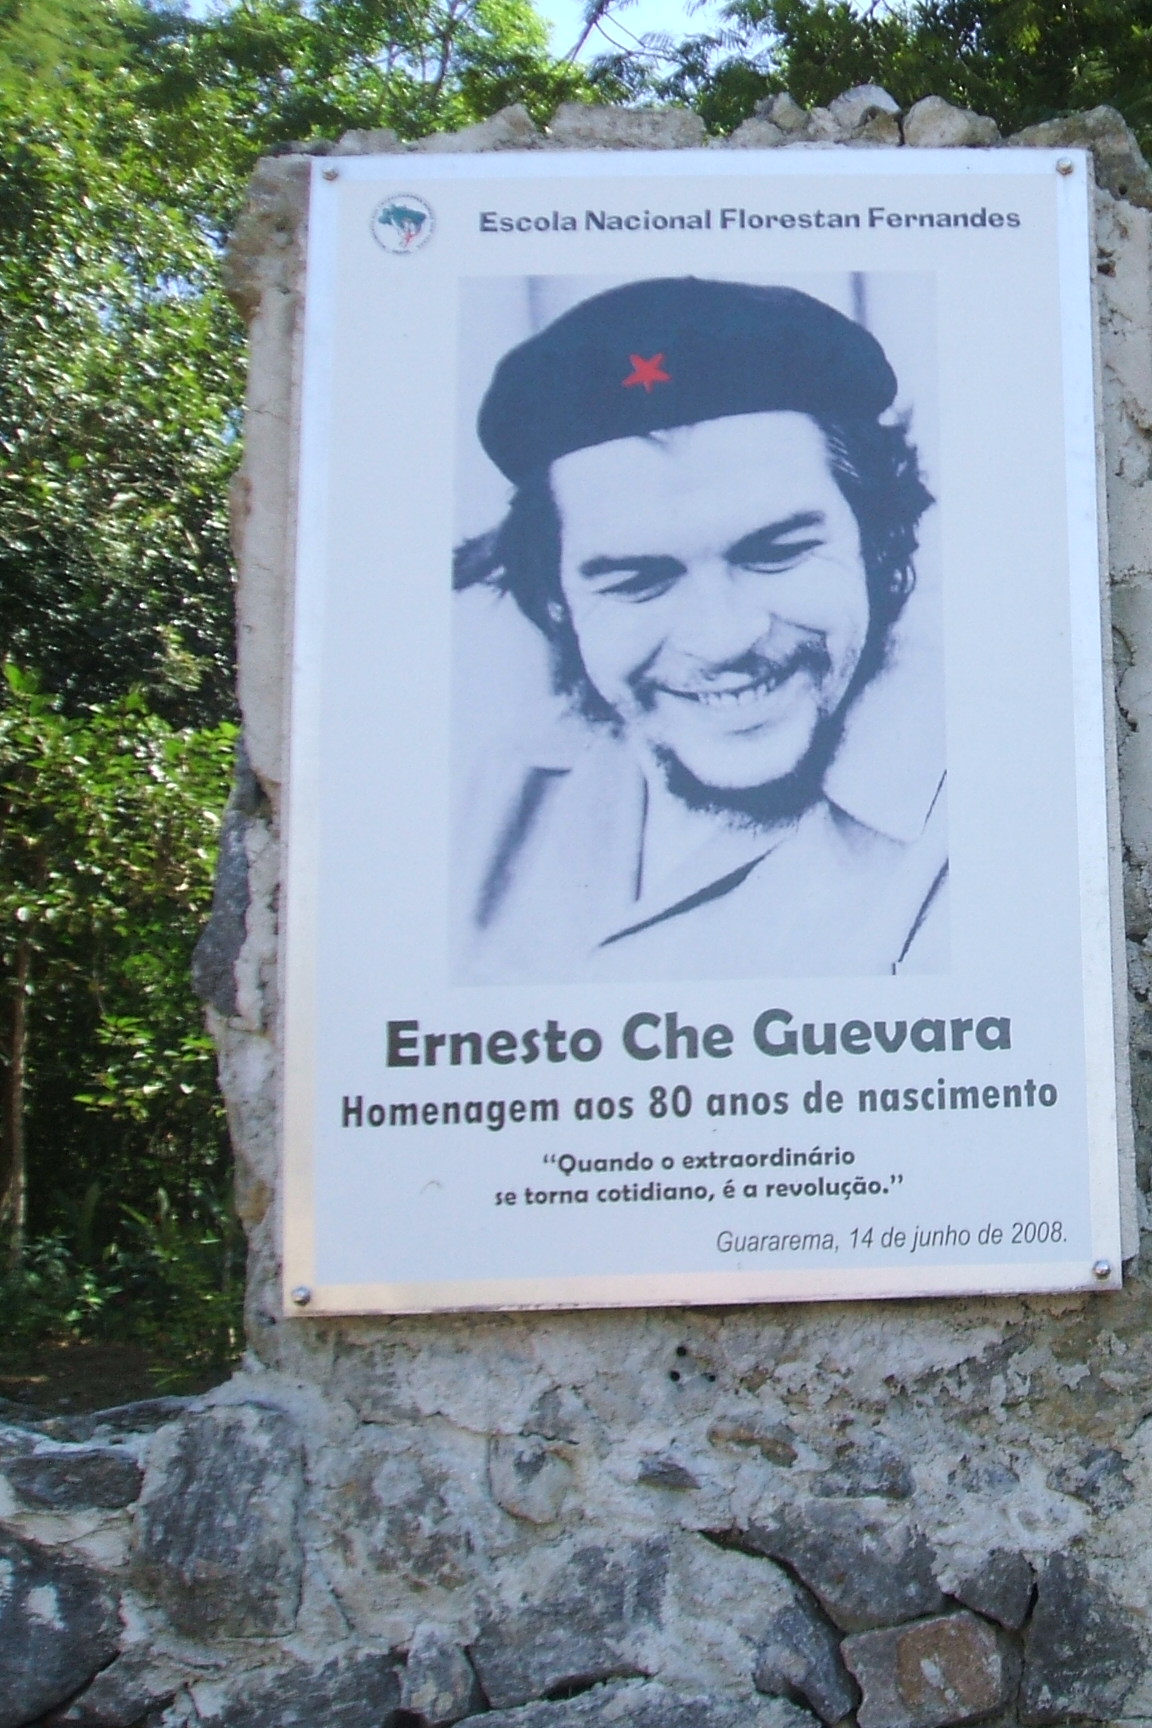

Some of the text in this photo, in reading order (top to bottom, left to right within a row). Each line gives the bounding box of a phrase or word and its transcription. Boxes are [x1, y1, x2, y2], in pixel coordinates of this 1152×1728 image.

[479, 206, 1022, 233] Escola Nacional Florestan Fernandes
[385, 1007, 1012, 1068] Ernesto Che Guevara
[341, 1077, 1058, 1133] Homenagem aos 80 anos de nascimento
[542, 1145, 856, 1178] “Quando o extraordinário
[494, 1173, 904, 1207] se torna cotidiano, é a revolução.”
[716, 1220, 1067, 1254] Guararema, 14 de junho de 2008.
